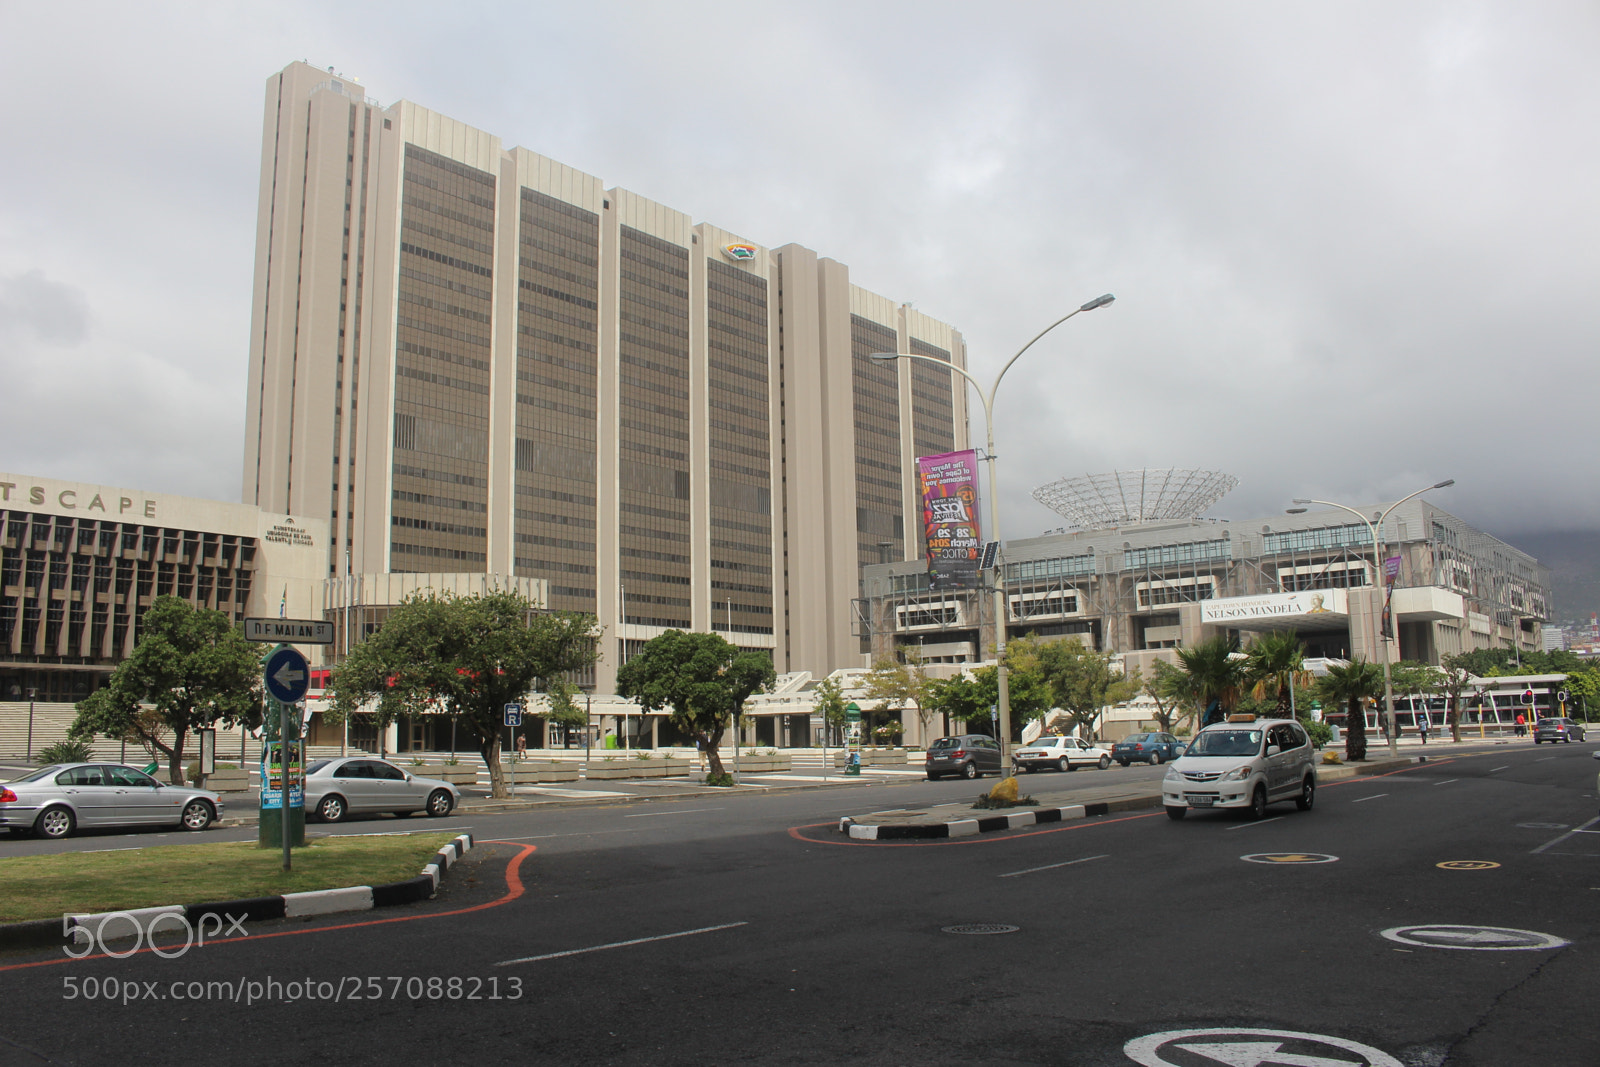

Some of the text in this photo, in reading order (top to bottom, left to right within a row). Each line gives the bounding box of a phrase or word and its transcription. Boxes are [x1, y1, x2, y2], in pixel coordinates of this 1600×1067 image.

[1241, 600, 1271, 608] HONOURS
[1206, 603, 1302, 619] NELSON MANDELA
[317, 625, 325, 634] ST
[508, 714, 517, 725] R
